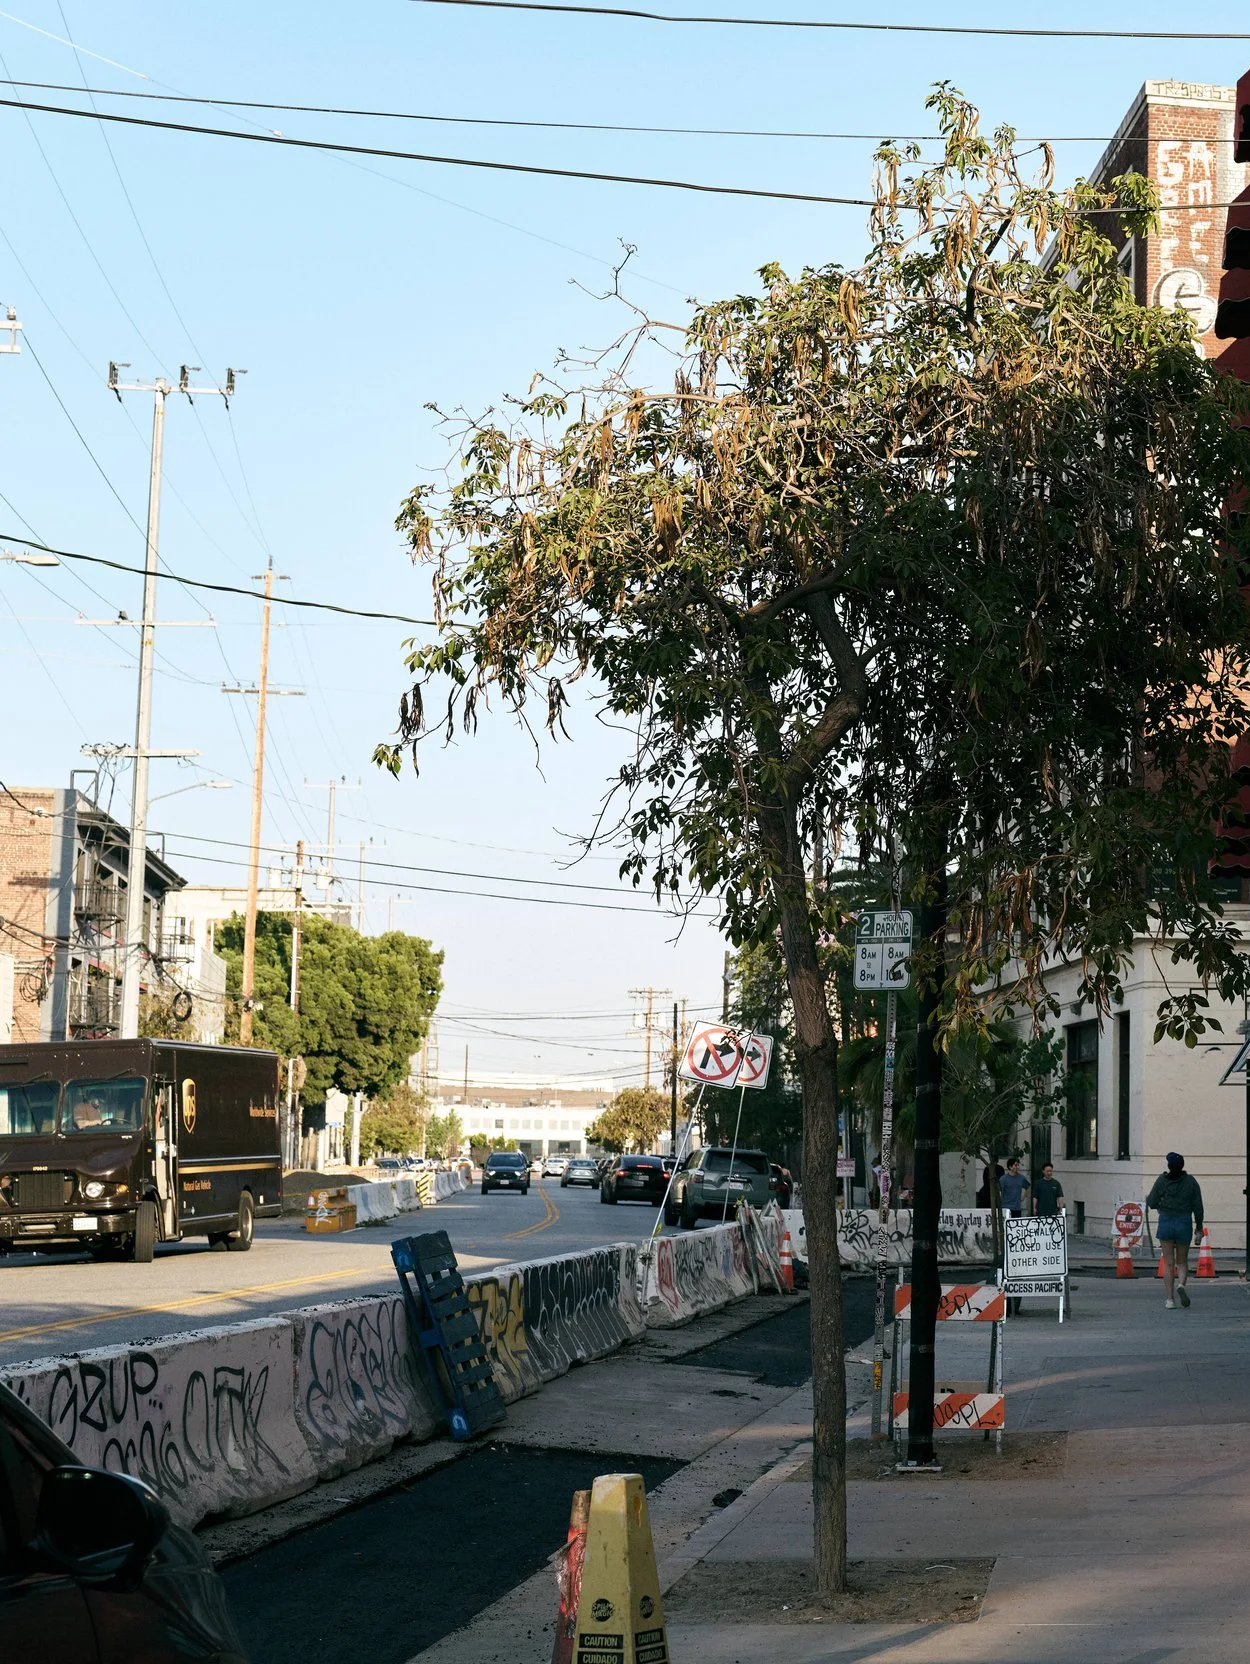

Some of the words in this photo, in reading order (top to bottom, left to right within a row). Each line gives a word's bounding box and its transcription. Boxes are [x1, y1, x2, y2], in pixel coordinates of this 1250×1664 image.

[860, 915, 871, 935] 2
[875, 922, 909, 937] PARKING
[1045, 1242, 1062, 1251] USE
[1011, 1257, 1038, 1268] OTHER
[1042, 1256, 1061, 1266] SIDE
[1003, 1282, 1033, 1294] ACCESS
[1034, 1281, 1063, 1293] PACIFIC
[584, 1636, 618, 1647] CAUTION
[582, 1653, 618, 1664] CUIDADO
